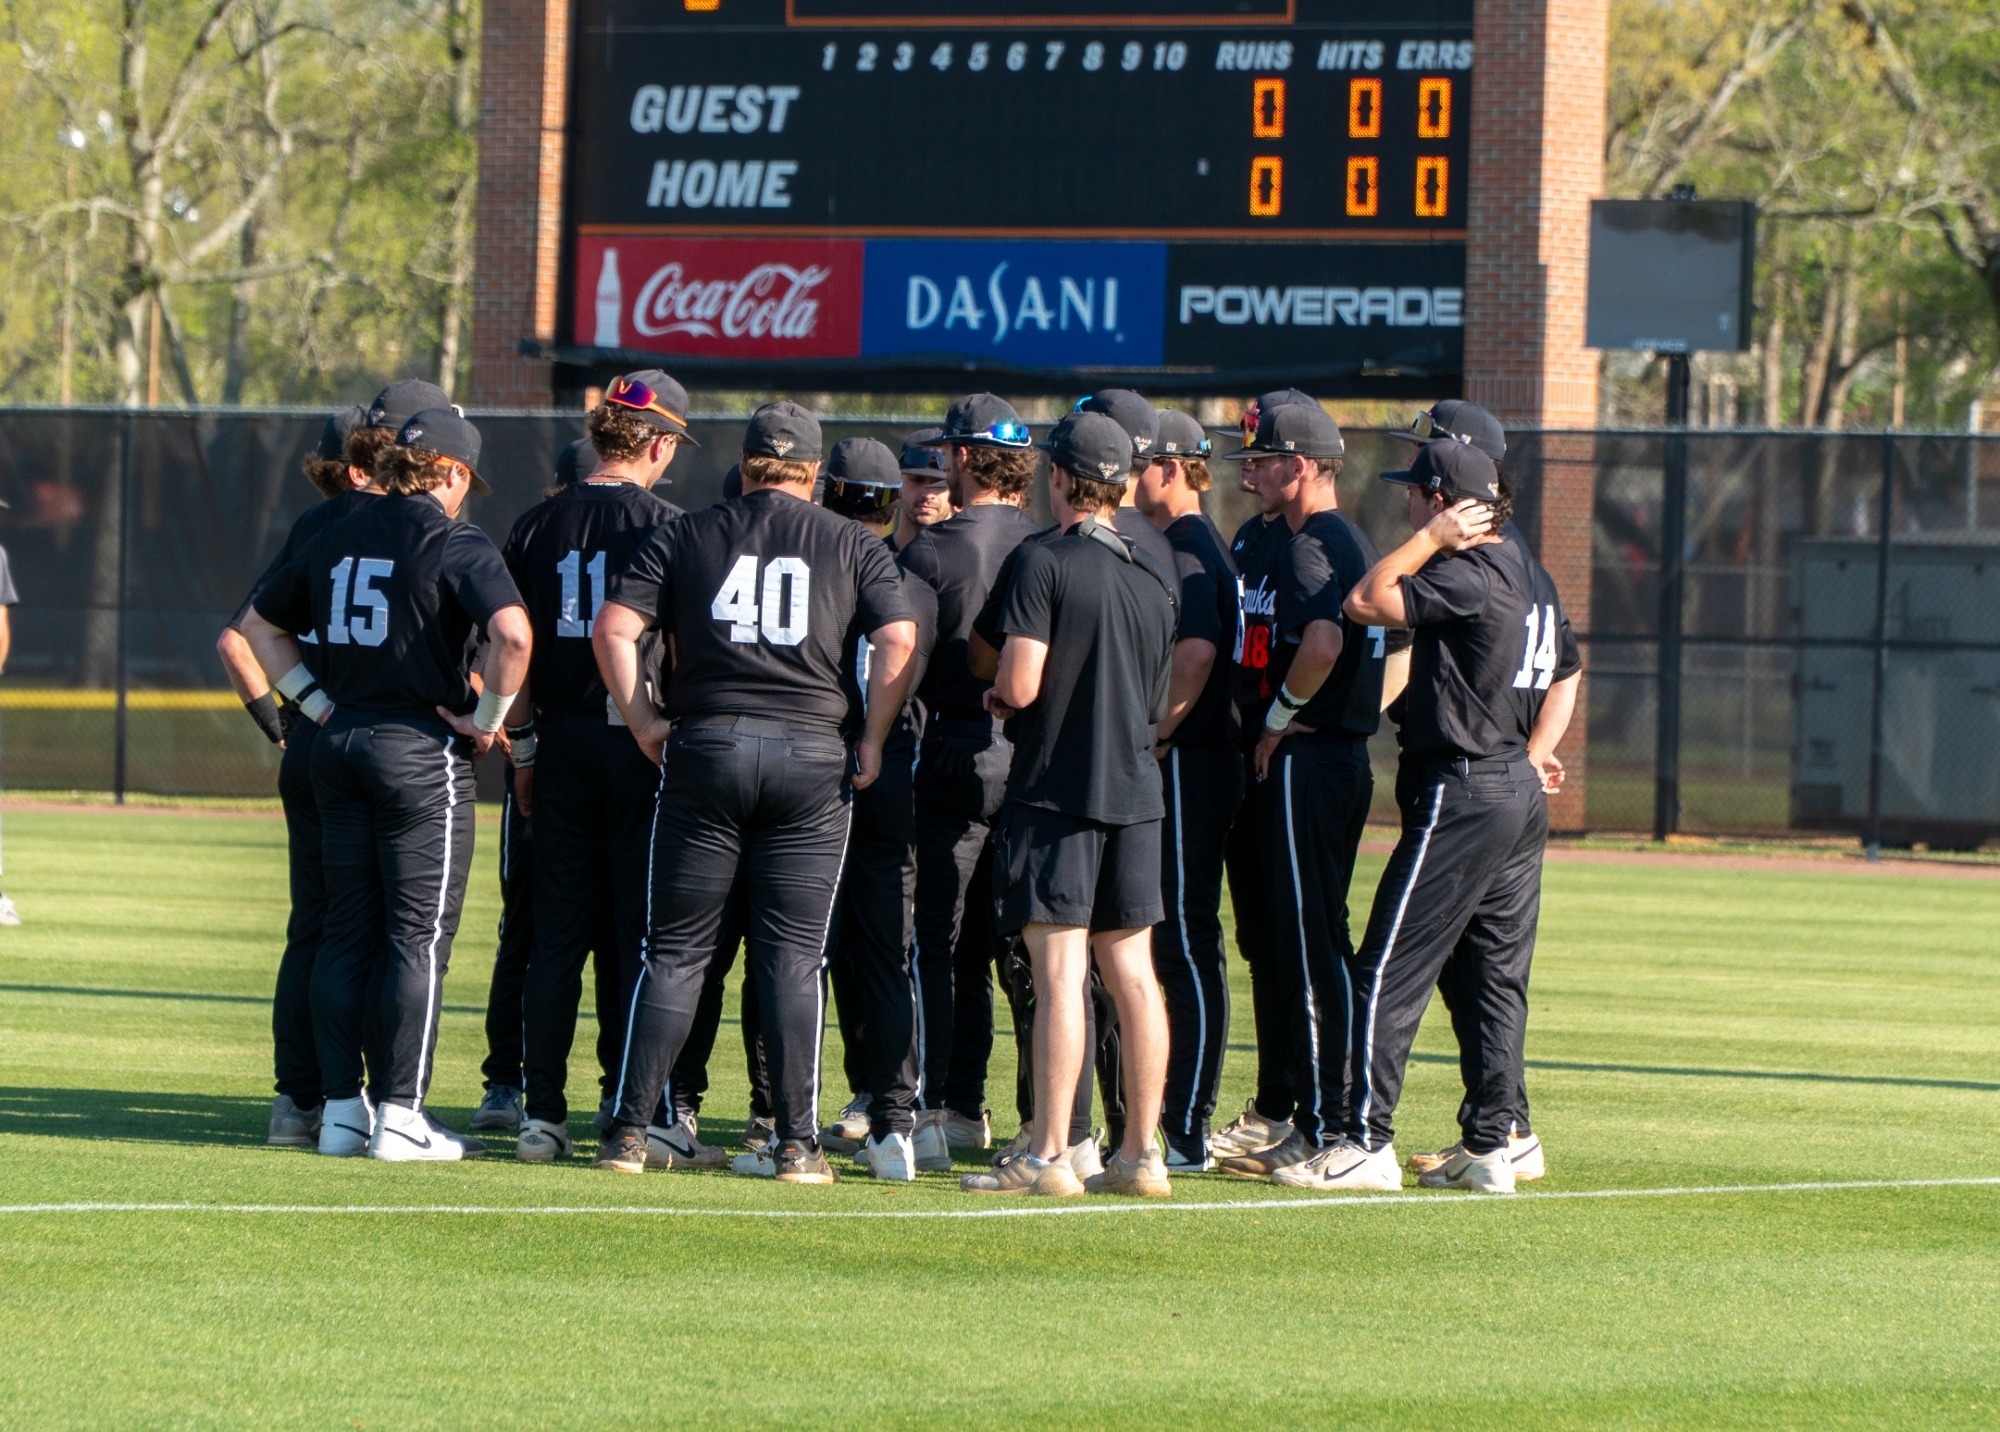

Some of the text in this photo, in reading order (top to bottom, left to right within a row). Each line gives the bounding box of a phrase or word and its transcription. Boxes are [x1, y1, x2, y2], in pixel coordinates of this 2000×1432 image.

[822, 40, 1476, 71] 1 2 3 4 5 6 7 8 9 10 RUNS HITS ERRS
[630, 78, 1451, 137] GUEST 0 0 0
[646, 156, 1449, 216] HOME 0 0 0
[906, 259, 1119, 345] DASANI
[1180, 286, 1464, 326] POWERADE
[327, 557, 395, 647] 15
[556, 550, 606, 638] 11
[711, 555, 810, 646] 40
[1242, 624, 1269, 668] 18
[1512, 603, 1557, 690] 14
